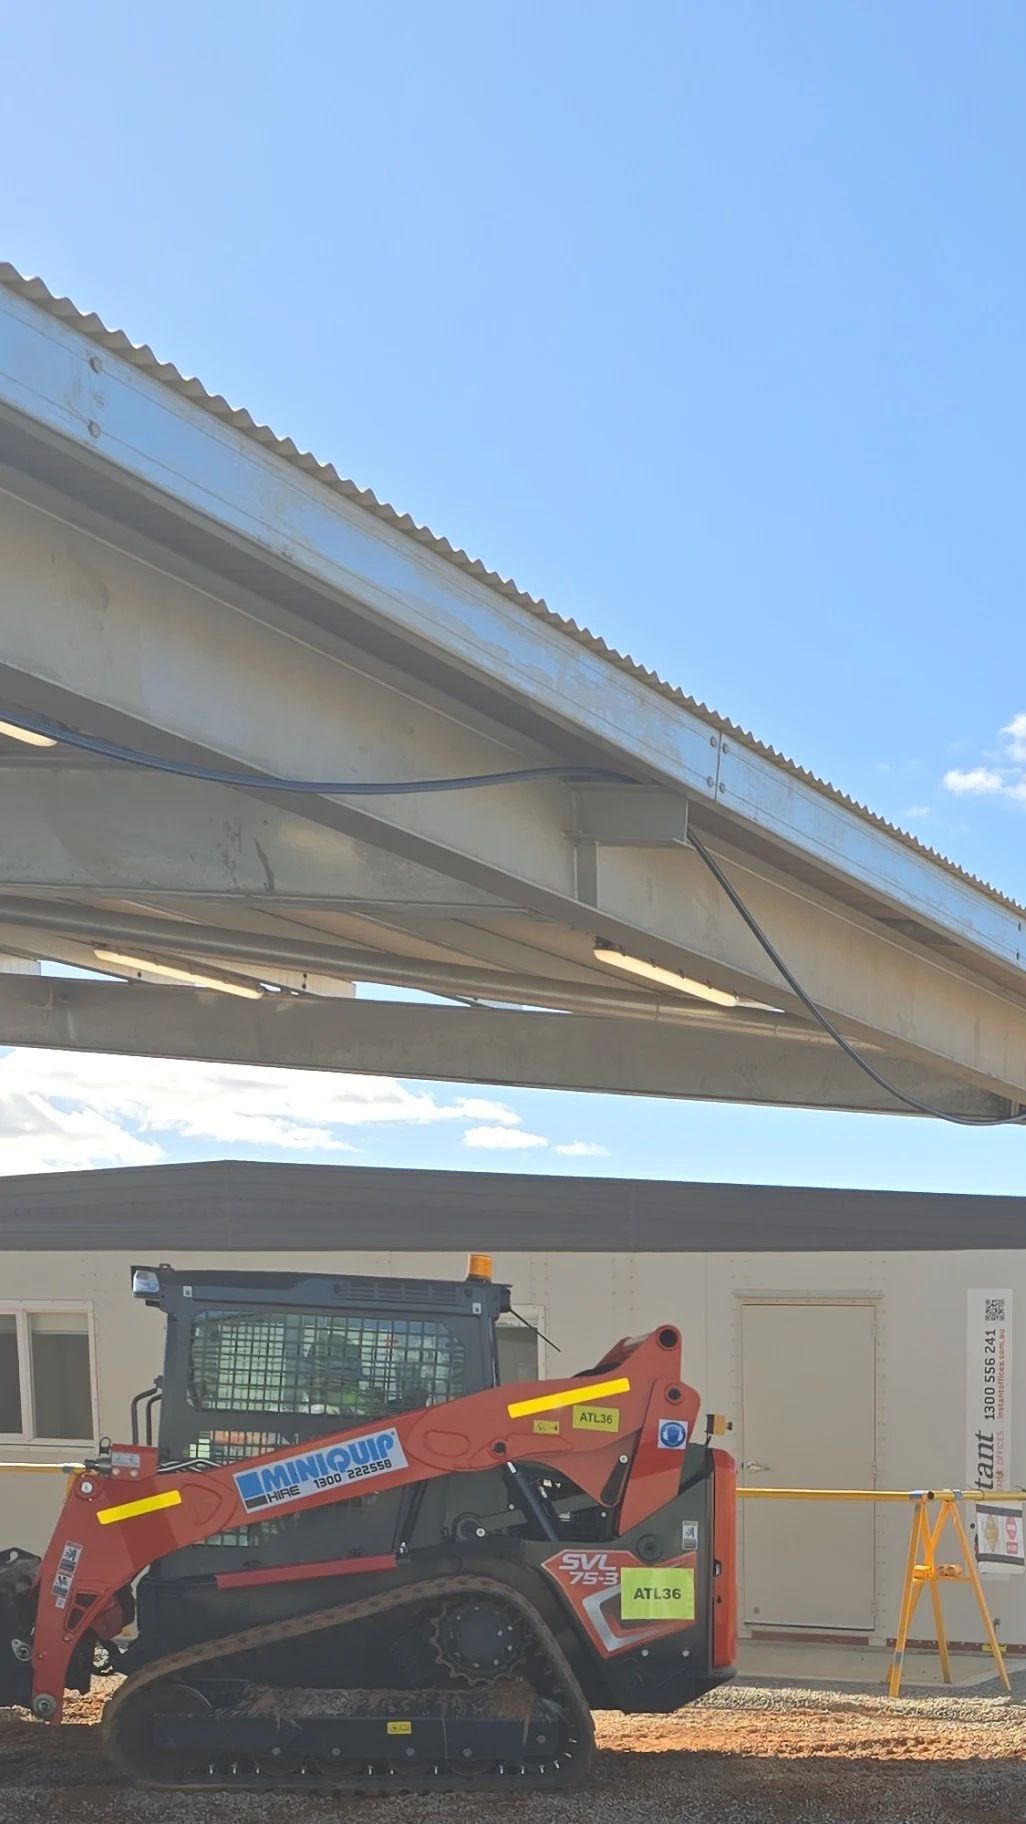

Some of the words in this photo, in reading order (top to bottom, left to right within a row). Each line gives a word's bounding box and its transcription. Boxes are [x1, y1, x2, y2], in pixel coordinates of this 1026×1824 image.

[984, 1329, 996, 1354] 241
[984, 1358, 996, 1383] 556
[984, 1387, 996, 1420] 1300
[579, 1411, 613, 1425] ATL36
[260, 1433, 394, 1493] MINIQUIP
[974, 1429, 994, 1490] tant
[313, 1473, 342, 1489] 1300
[347, 1459, 393, 1479] 222558
[267, 1485, 301, 1503] HIRE
[559, 1553, 617, 1571] SVL
[569, 1571, 619, 1585] 75-3
[633, 1587, 682, 1600] ATL36
